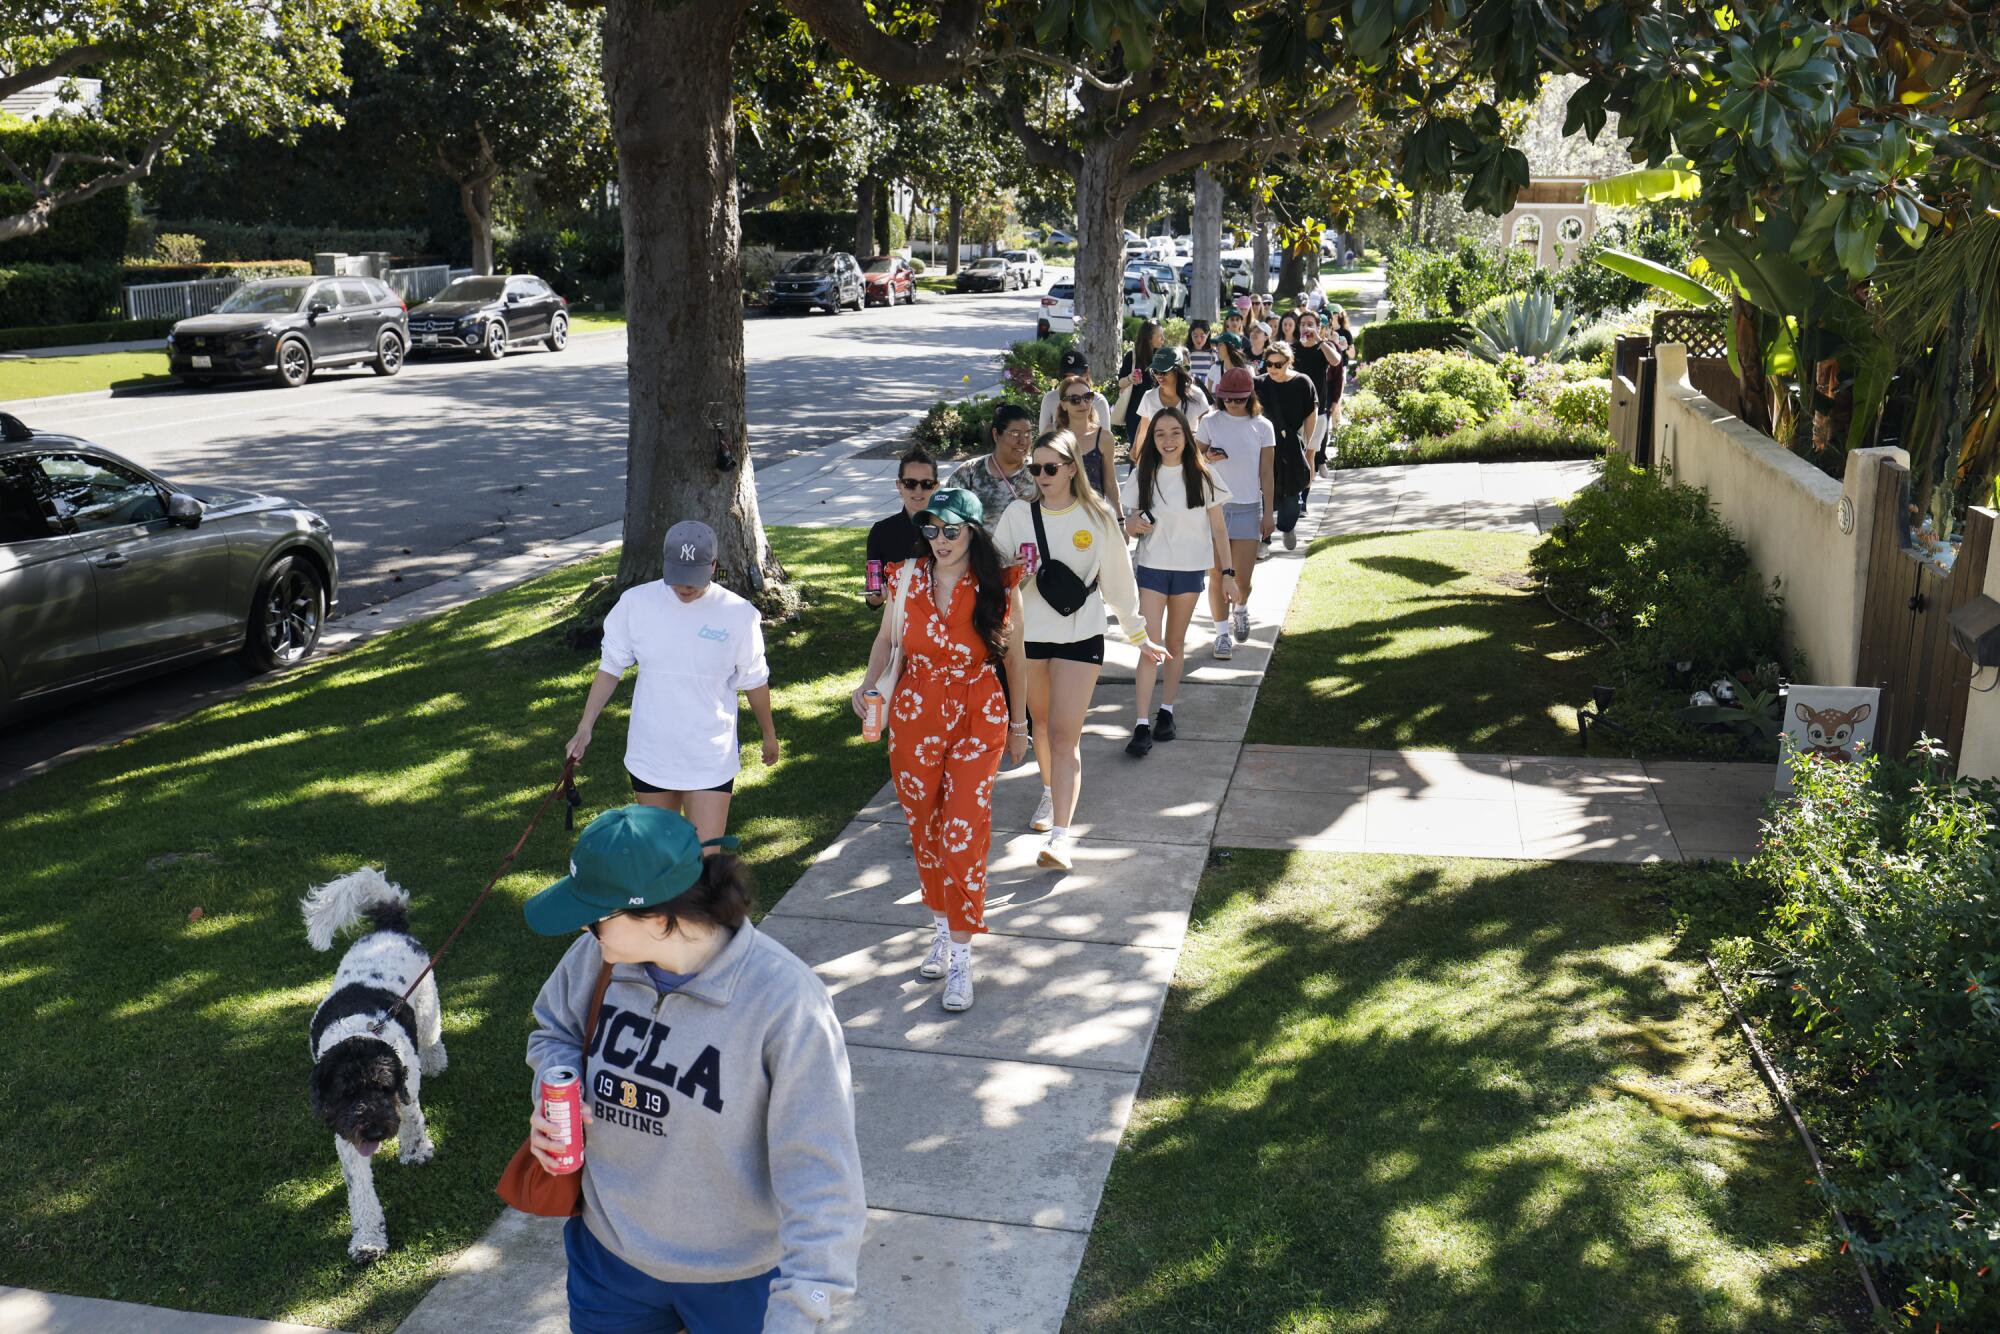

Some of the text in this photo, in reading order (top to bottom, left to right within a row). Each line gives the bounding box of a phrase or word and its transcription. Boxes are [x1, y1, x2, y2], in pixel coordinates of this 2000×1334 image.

[680, 543, 696, 560] NY
[598, 1075, 614, 1097] 19
[644, 1091, 662, 1113] 19
